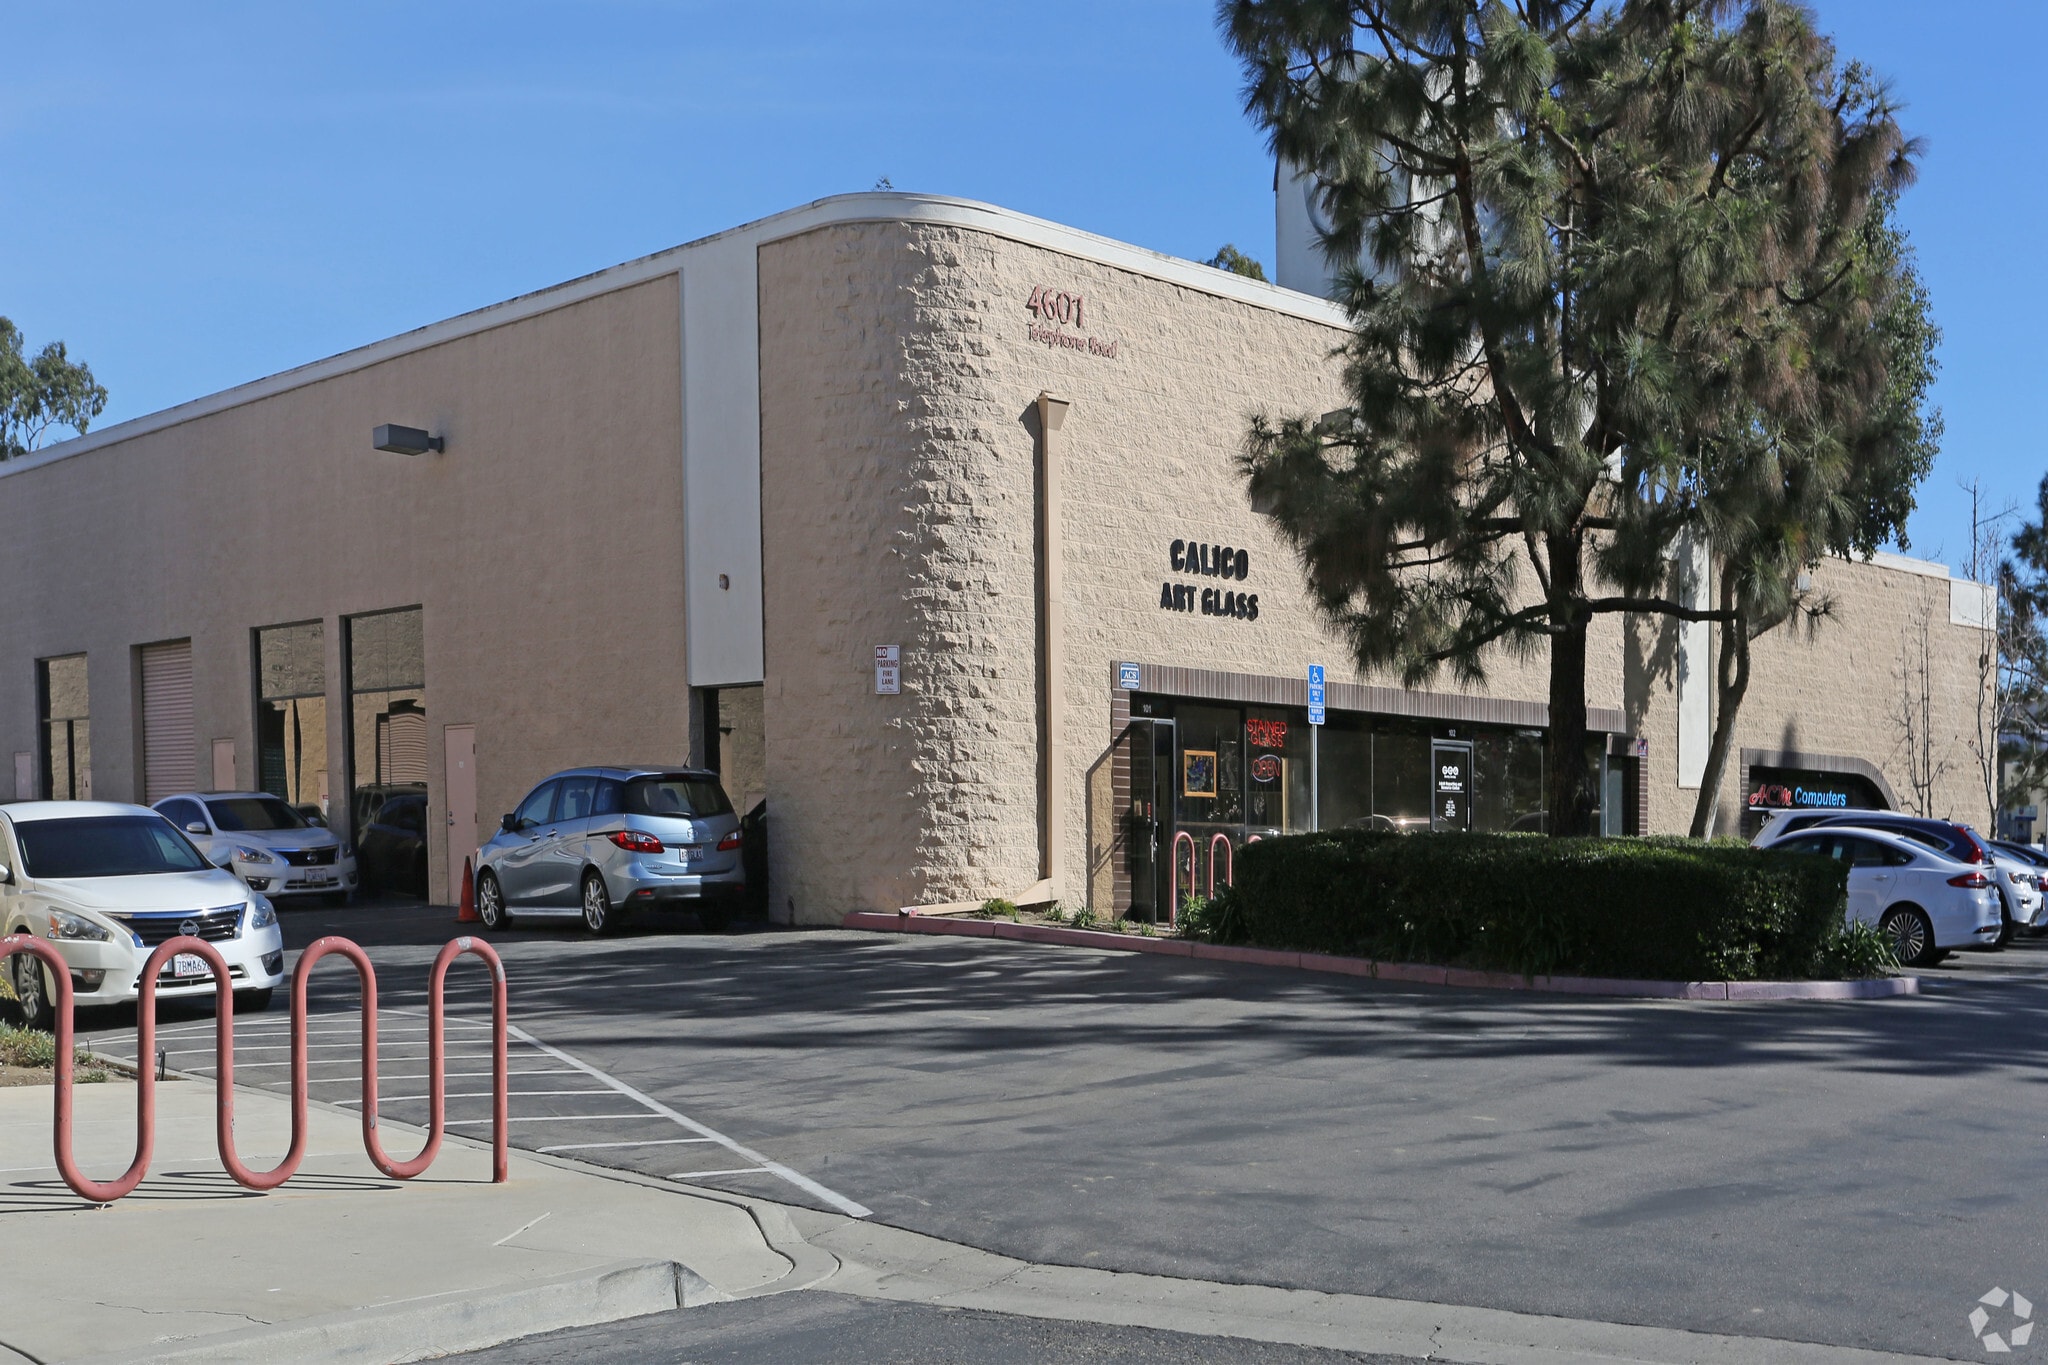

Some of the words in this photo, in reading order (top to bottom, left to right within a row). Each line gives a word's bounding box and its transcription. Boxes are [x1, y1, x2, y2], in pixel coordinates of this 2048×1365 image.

[1025, 284, 1084, 328] 4601
[1026, 321, 1087, 352] Telephone
[1088, 335, 1118, 359] Road
[1170, 539, 1249, 582] CALICO
[1160, 582, 1197, 613] ART
[1201, 587, 1259, 622] GLASS
[876, 648, 887, 657] NO
[877, 659, 898, 668] PARKING
[1123, 671, 1137, 680] ACS
[1247, 719, 1288, 735] STAINED
[1251, 731, 1284, 748] GLASS
[1252, 759, 1281, 777] OPEN
[1795, 786, 1847, 807] Computers
